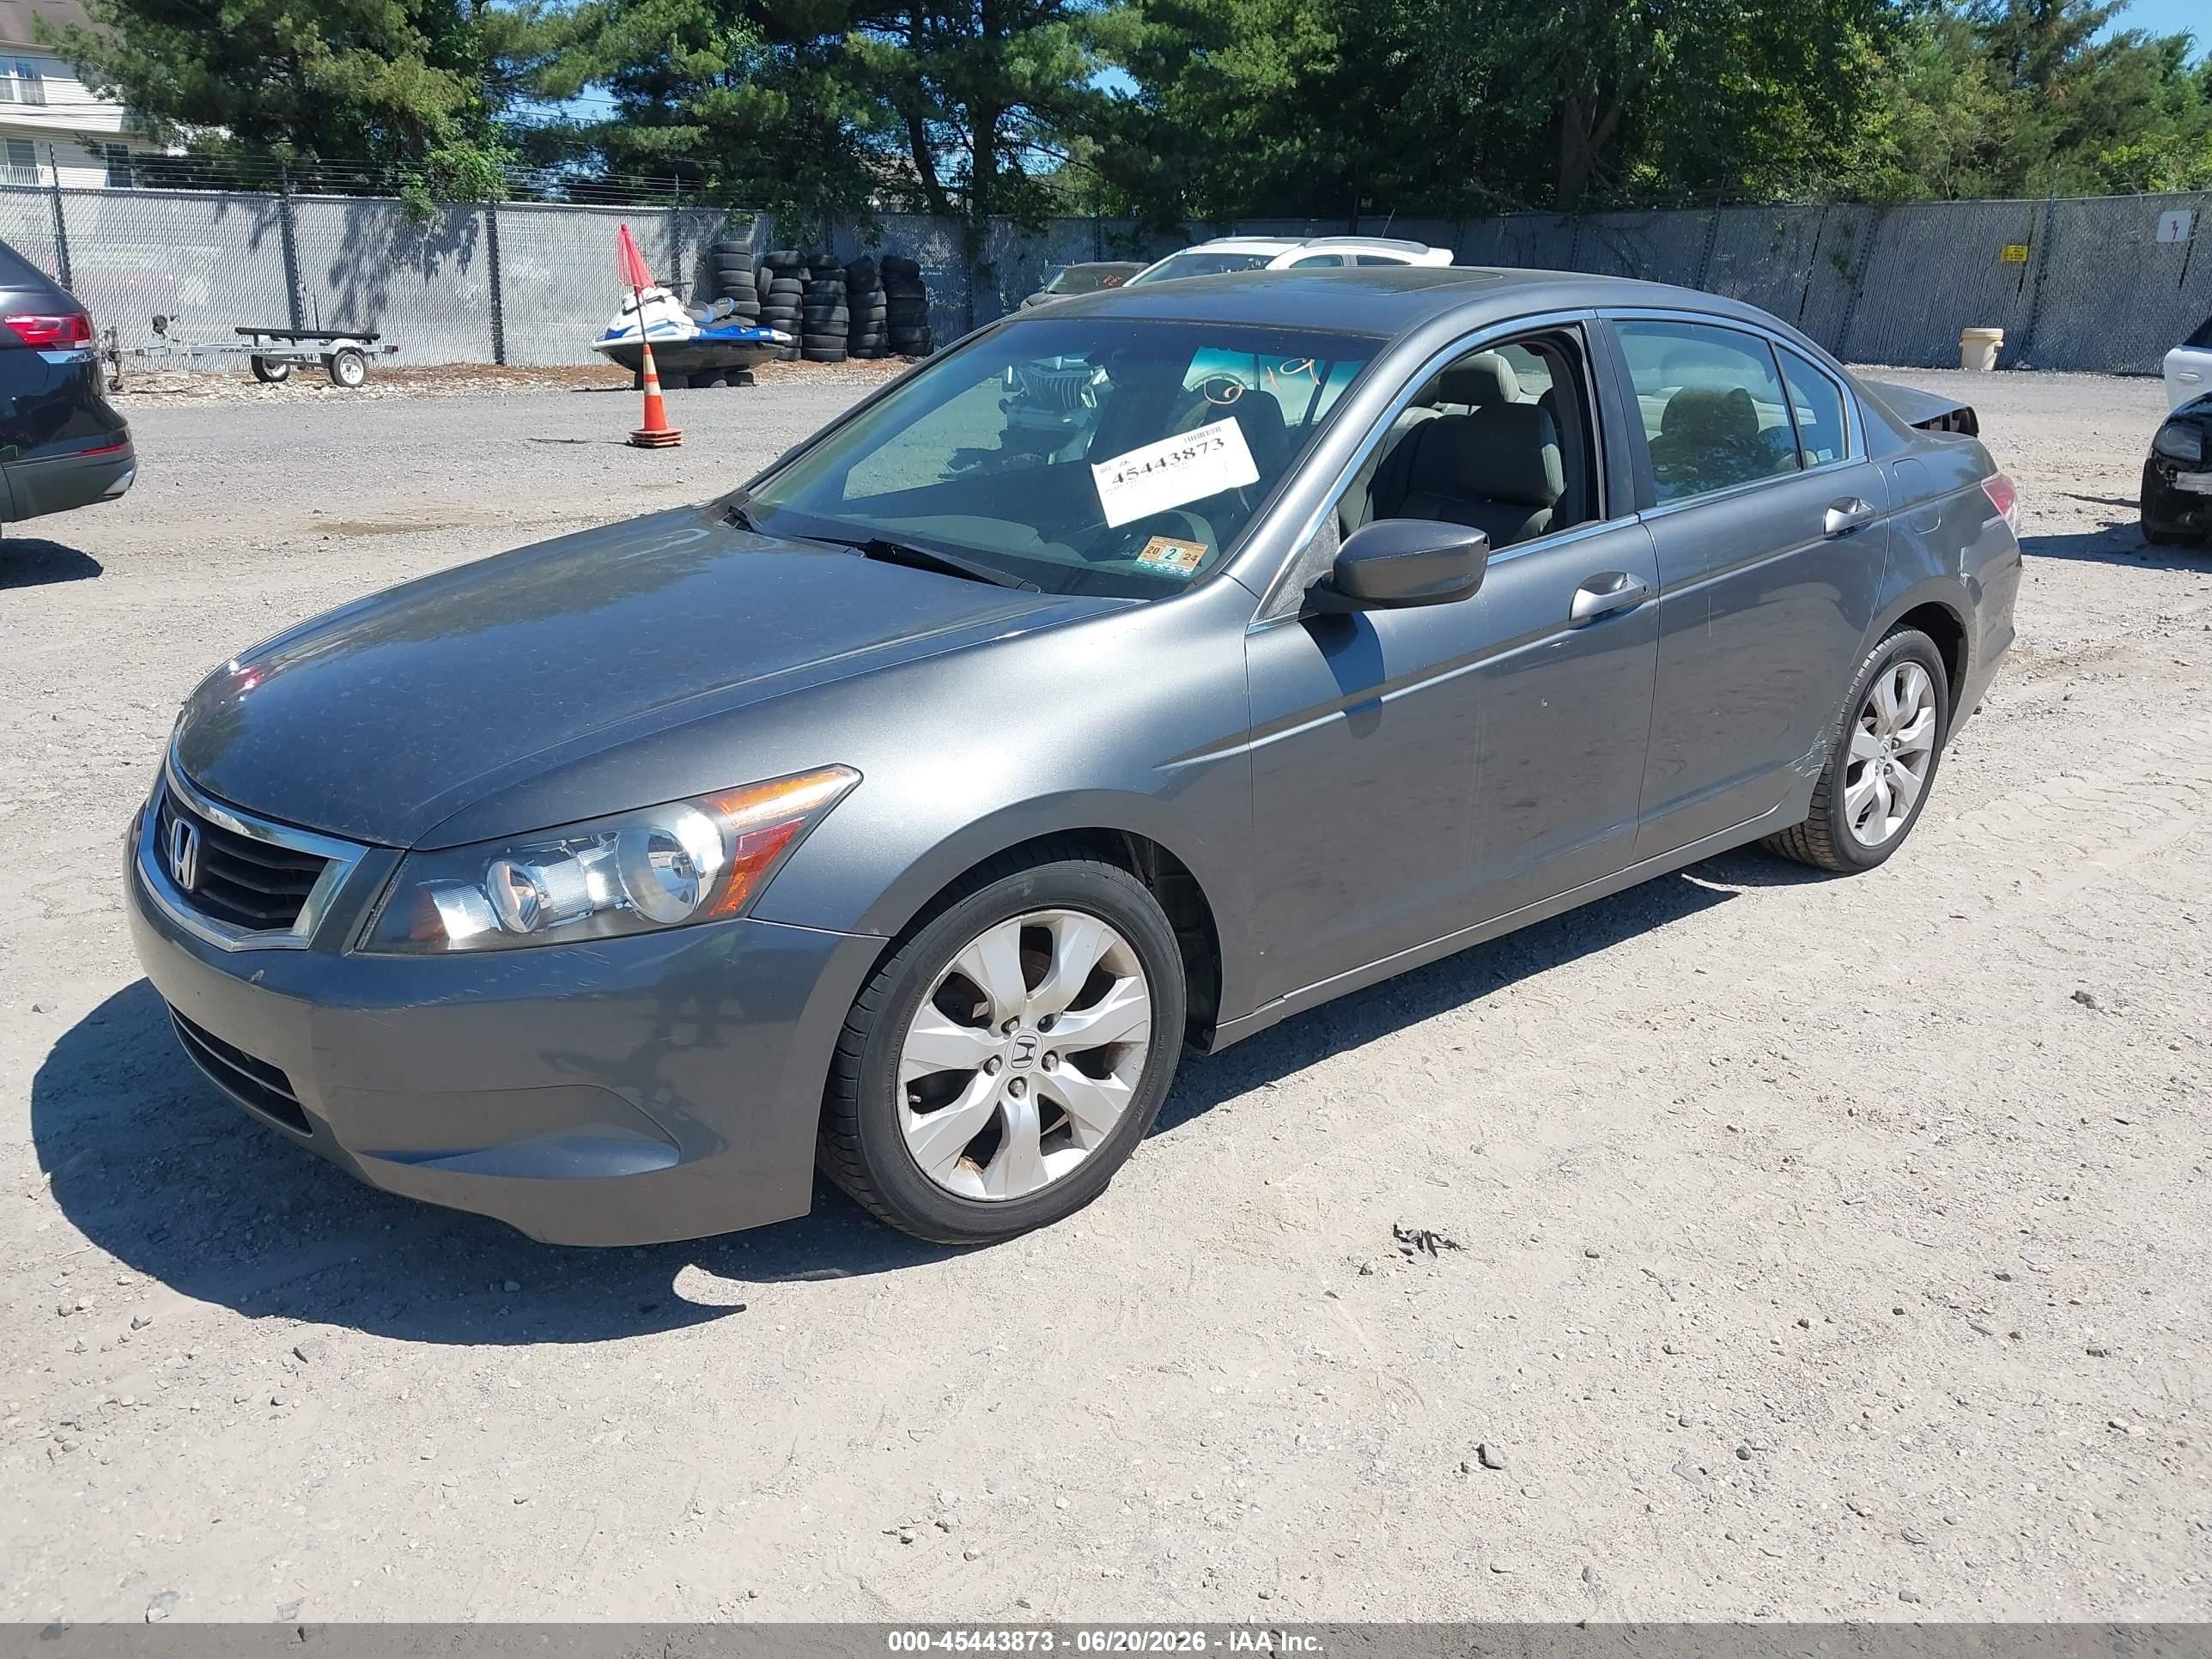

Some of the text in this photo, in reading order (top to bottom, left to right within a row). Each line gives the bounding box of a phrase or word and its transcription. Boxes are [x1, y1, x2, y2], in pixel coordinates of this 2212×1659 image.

[1113, 438, 1224, 483] 45443873
[1146, 546, 1198, 562] 20 2 24
